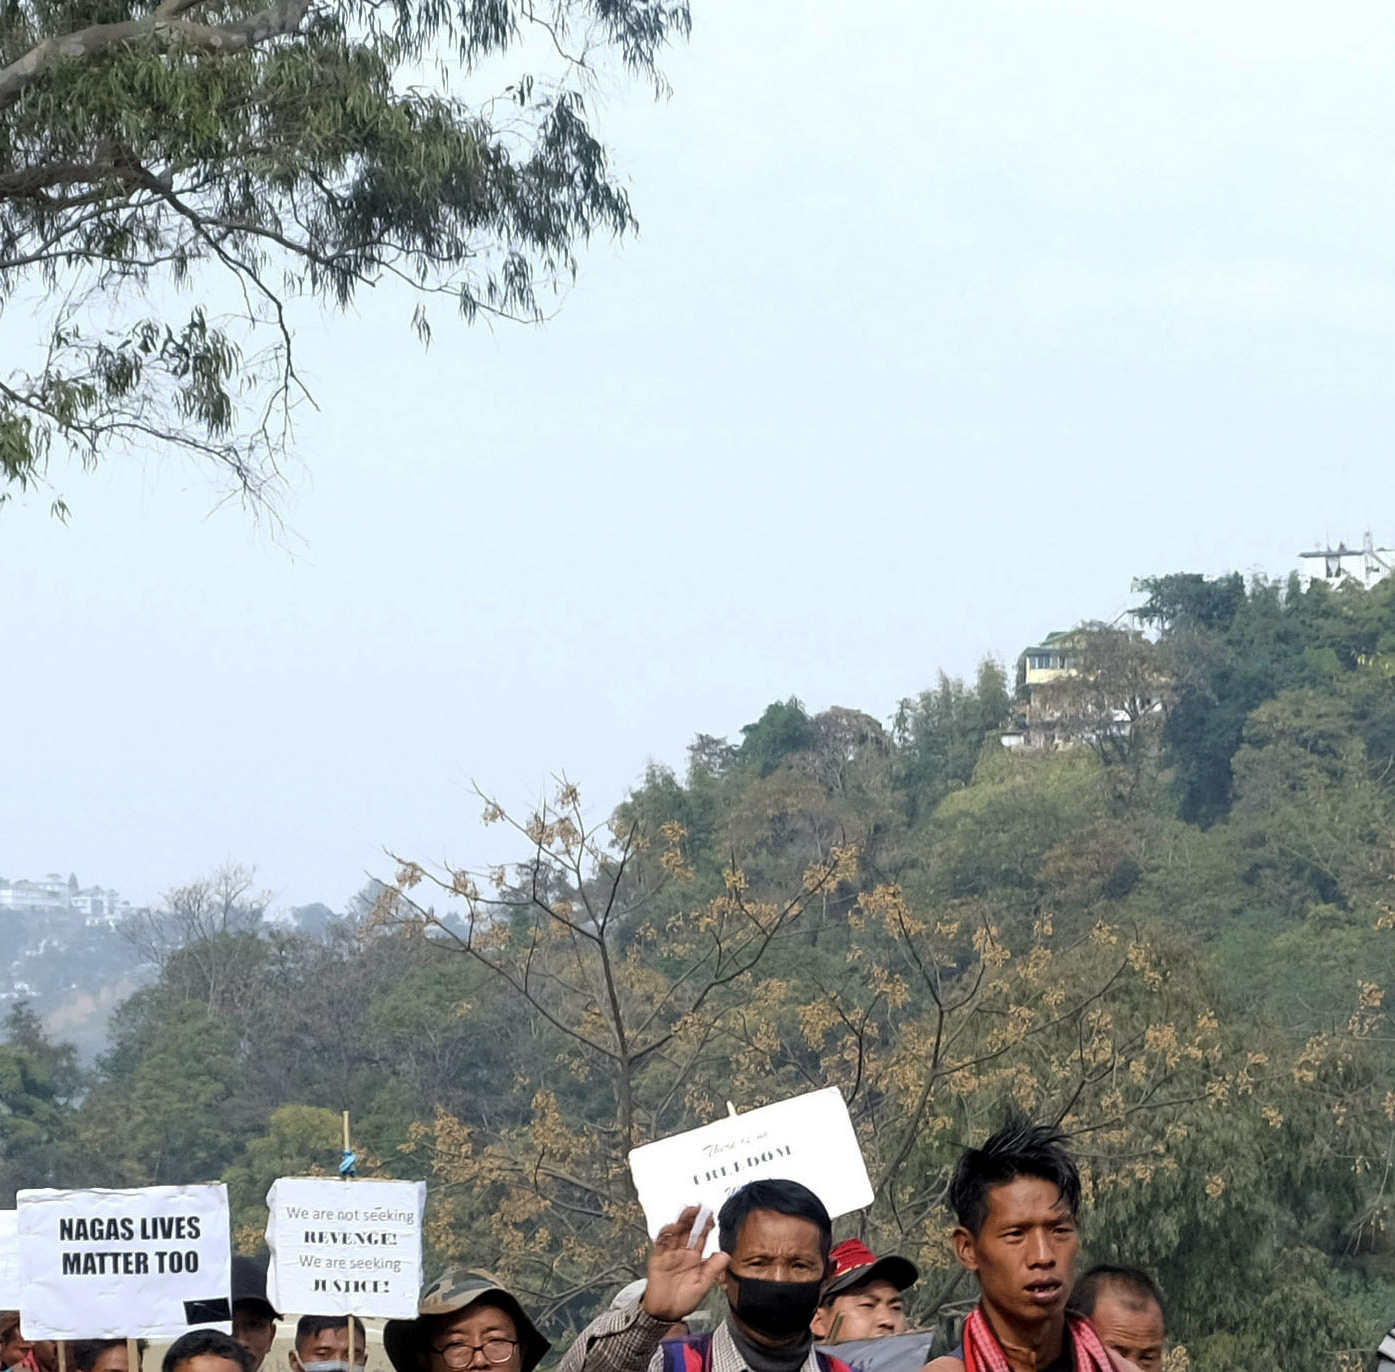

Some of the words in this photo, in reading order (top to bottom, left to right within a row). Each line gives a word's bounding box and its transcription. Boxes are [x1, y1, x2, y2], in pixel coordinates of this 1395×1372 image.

[693, 1145, 792, 1185] FREEDOM
[286, 1206, 309, 1220] We
[313, 1210, 334, 1221] are
[337, 1210, 359, 1222] not
[364, 1209, 415, 1225] seeking
[59, 1218, 134, 1242] NAGAS
[140, 1217, 201, 1240] LIVES
[304, 1230, 398, 1246] REVENGE!
[62, 1252, 149, 1276] MATTER
[155, 1250, 199, 1274] TOO
[299, 1254, 322, 1268] We
[326, 1258, 347, 1270] are
[349, 1257, 402, 1273] seeking
